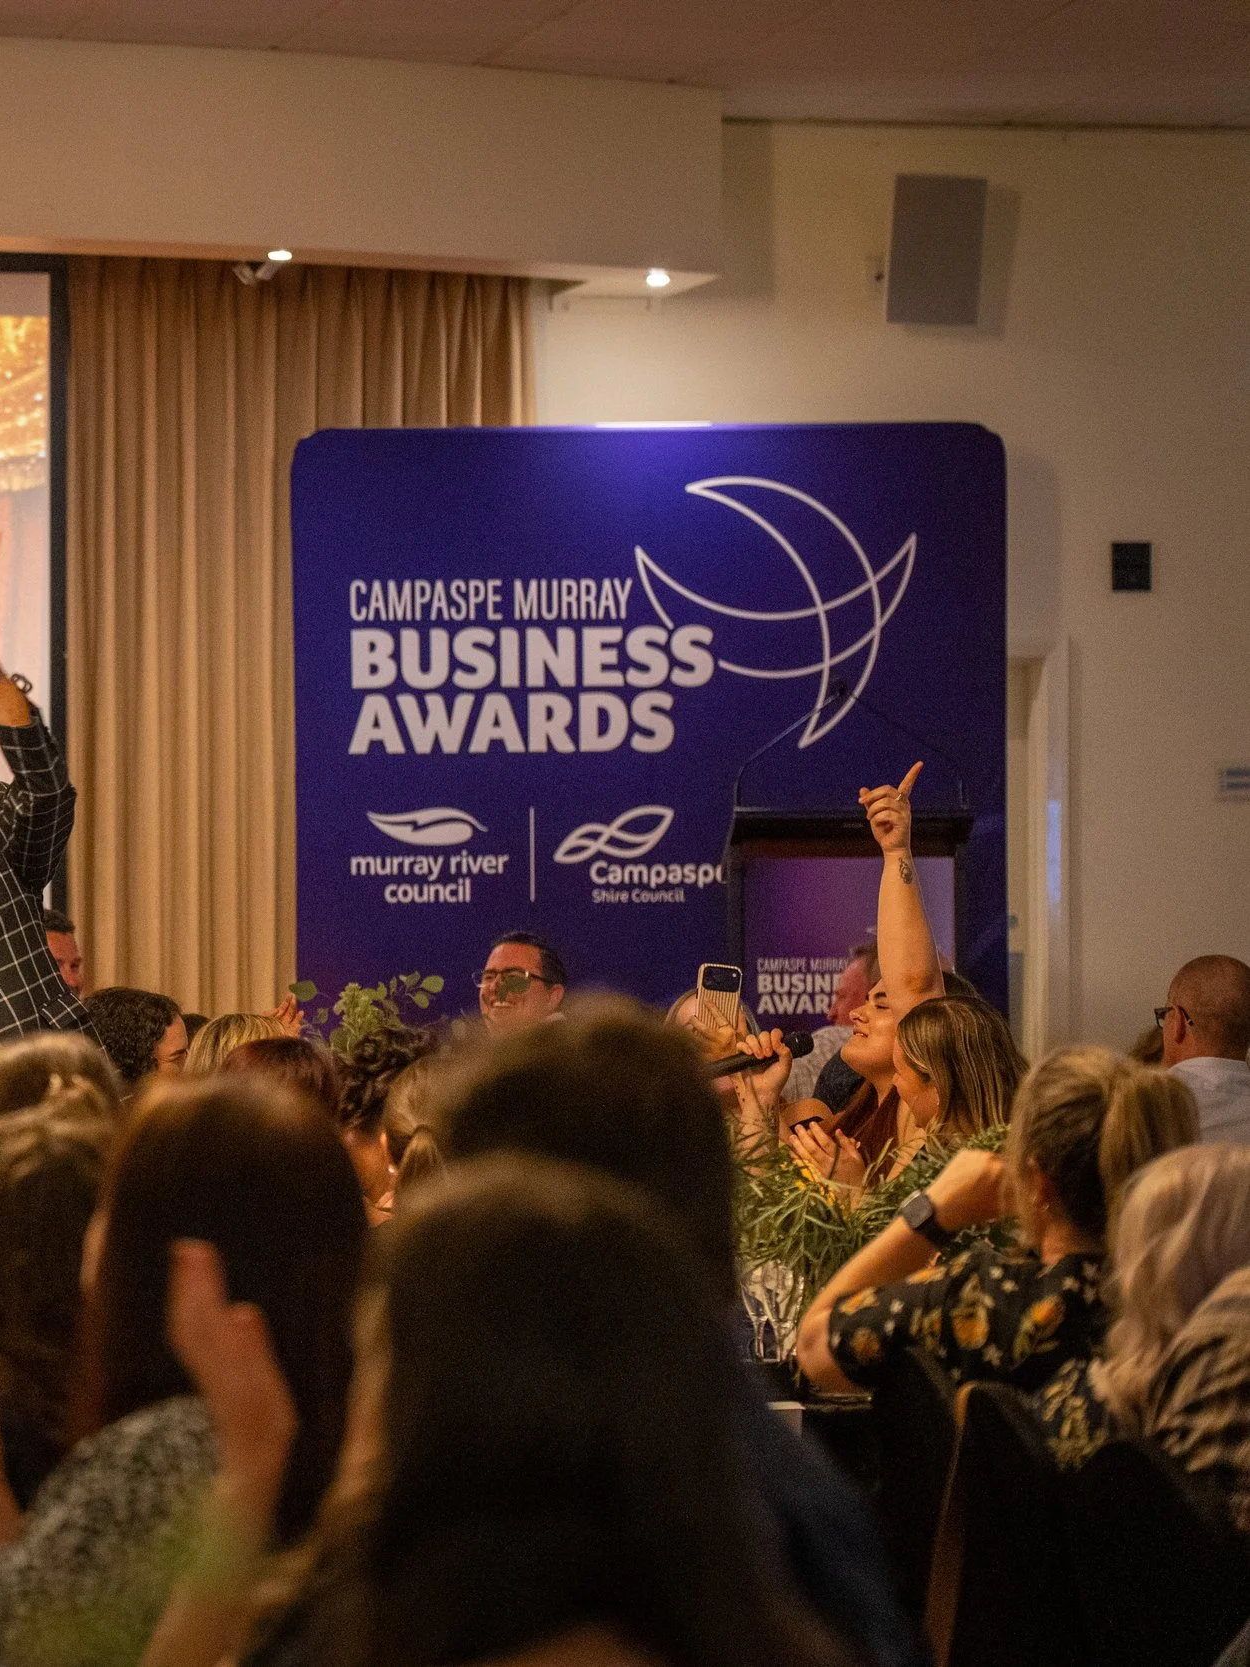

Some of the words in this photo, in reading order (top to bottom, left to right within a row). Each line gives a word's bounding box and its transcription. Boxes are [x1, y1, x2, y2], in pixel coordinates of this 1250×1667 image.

[350, 579, 503, 622] CAMPASPE
[513, 577, 633, 620] MURRAY
[350, 624, 715, 690] BUSINESS
[348, 690, 675, 755] AWARDS
[350, 855, 444, 882] murray
[450, 849, 509, 875] river
[383, 876, 472, 904] council
[591, 888, 629, 903] Shire
[631, 887, 685, 903] Council
[757, 973, 842, 994] BUSIN
[757, 994, 837, 1015] AWAR
